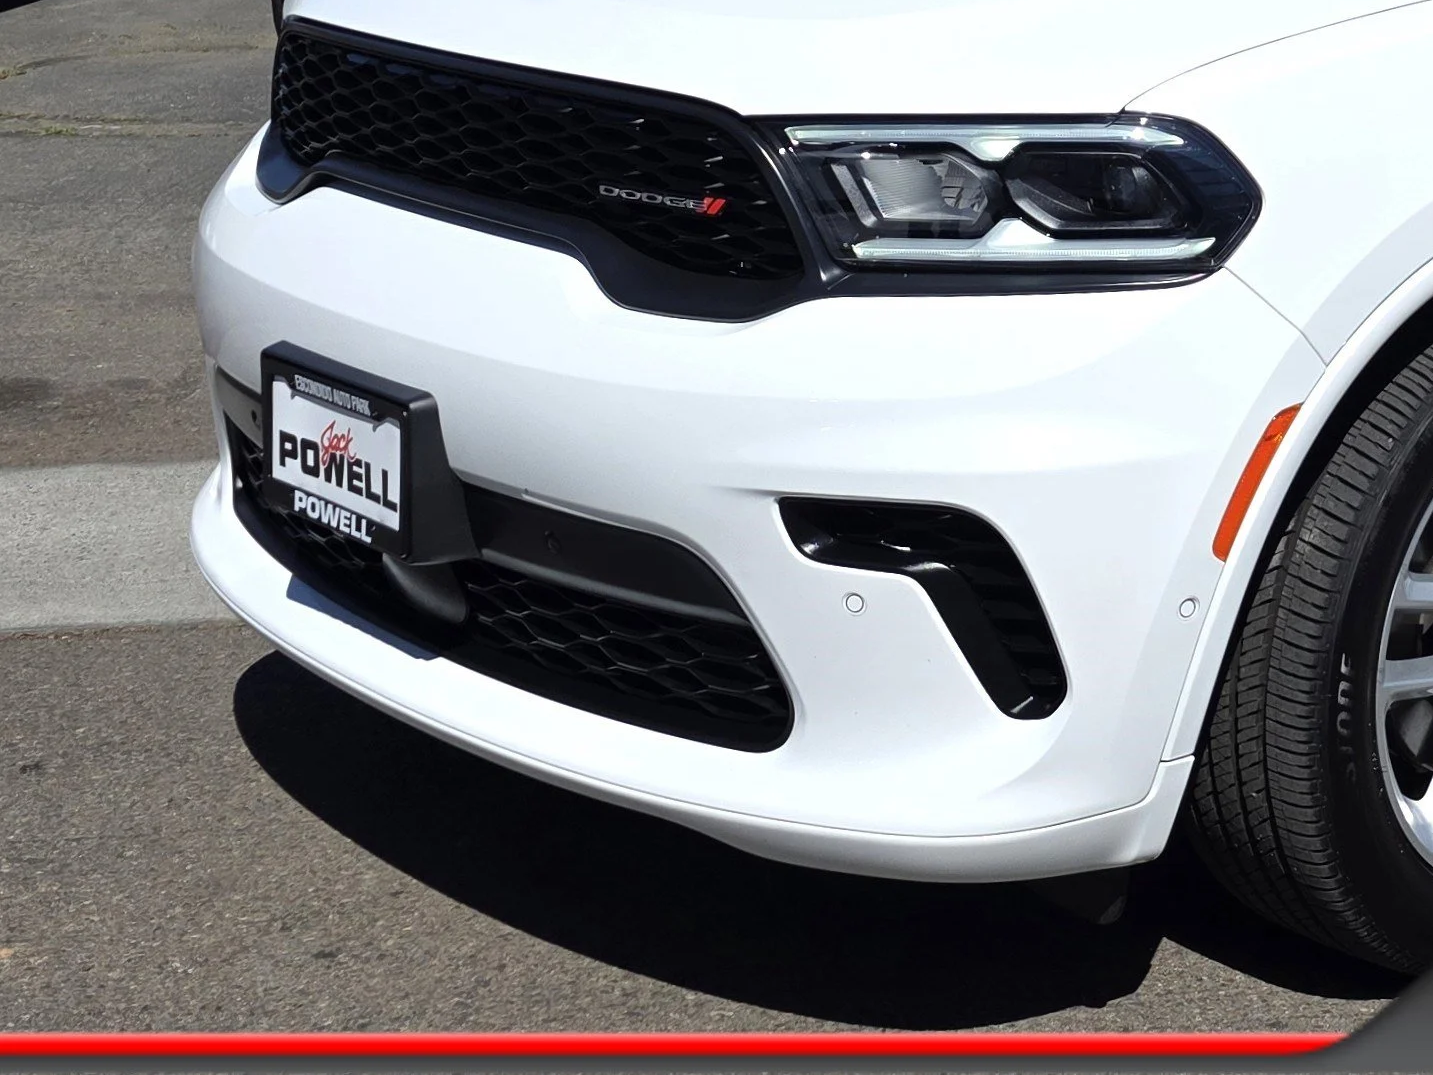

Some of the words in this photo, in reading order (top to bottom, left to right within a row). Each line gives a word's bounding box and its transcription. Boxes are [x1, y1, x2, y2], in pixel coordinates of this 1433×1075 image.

[599, 185, 707, 210] DODGE
[321, 420, 357, 469] Jack
[279, 429, 399, 513] POWELL
[294, 489, 372, 544] POWELL
